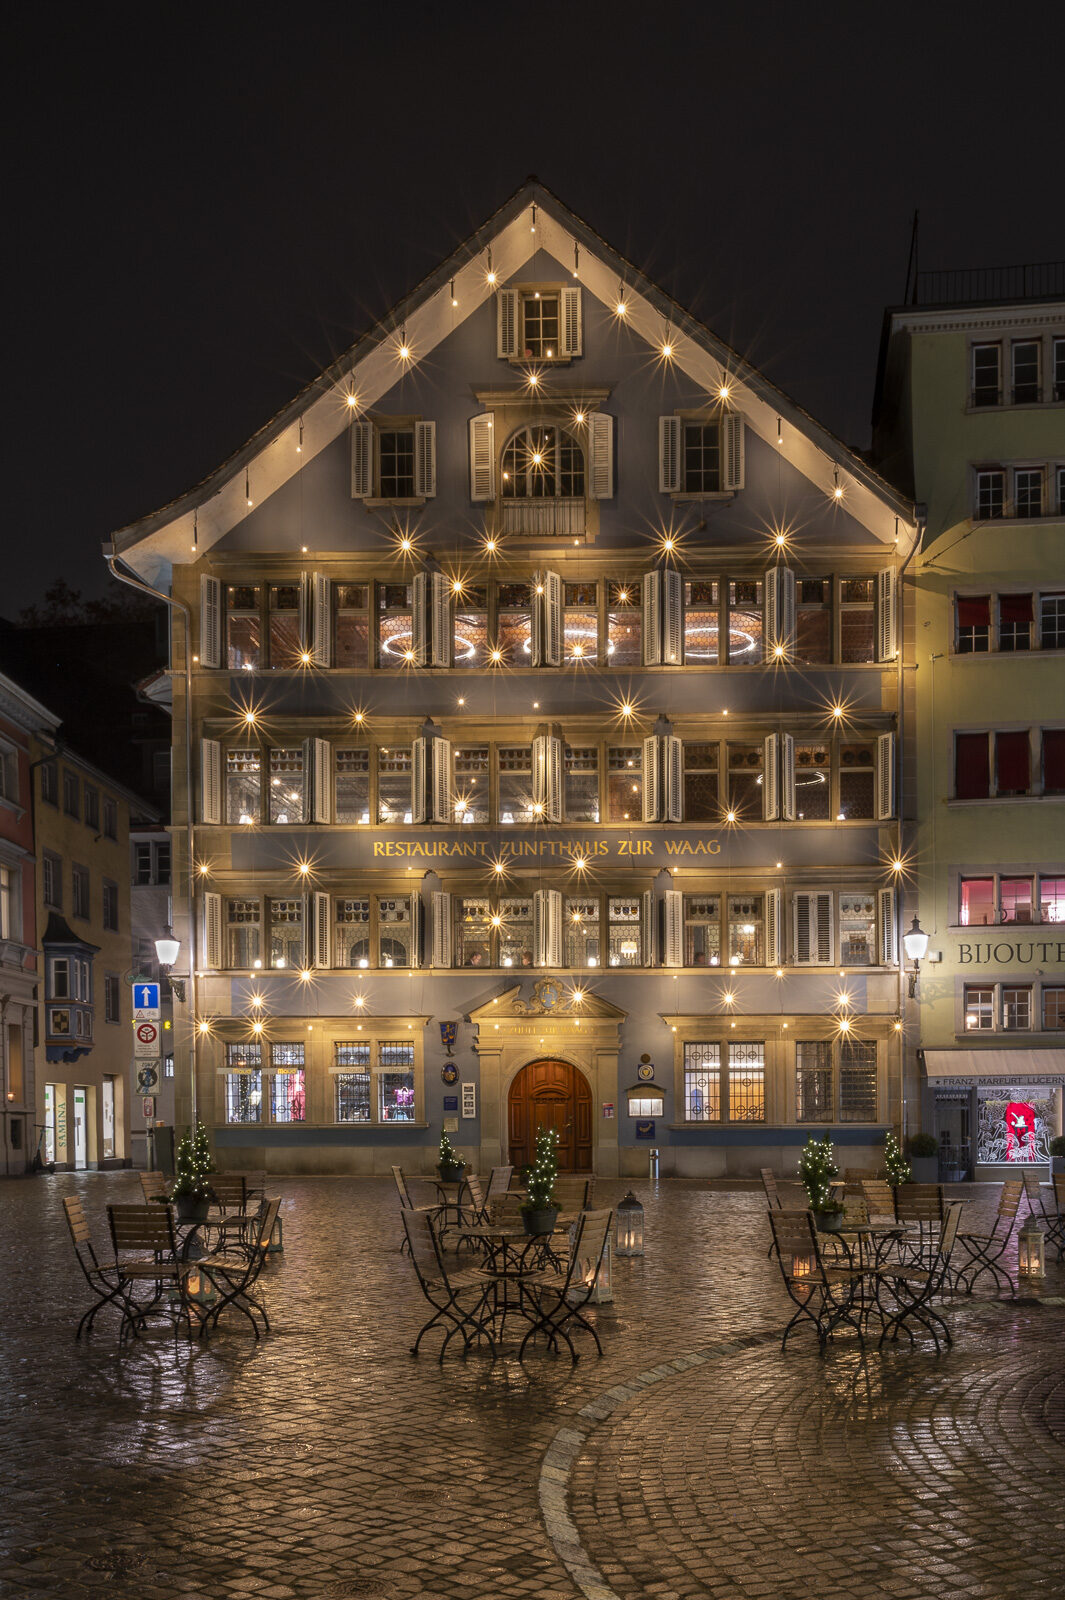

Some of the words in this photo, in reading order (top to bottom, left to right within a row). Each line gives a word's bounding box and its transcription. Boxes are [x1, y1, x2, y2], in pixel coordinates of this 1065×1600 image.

[373, 841, 491, 857] RESTAURANT
[500, 840, 609, 856] ZUNFTHAUS
[617, 840, 655, 855] ZUR
[664, 839, 721, 855] WAAG
[957, 942, 1065, 964] BIJOUTE
[979, 1077, 1025, 1085] MARFURT
[1027, 1076, 1065, 1084] LUCERN
[58, 1102, 67, 1147] SAMINA
